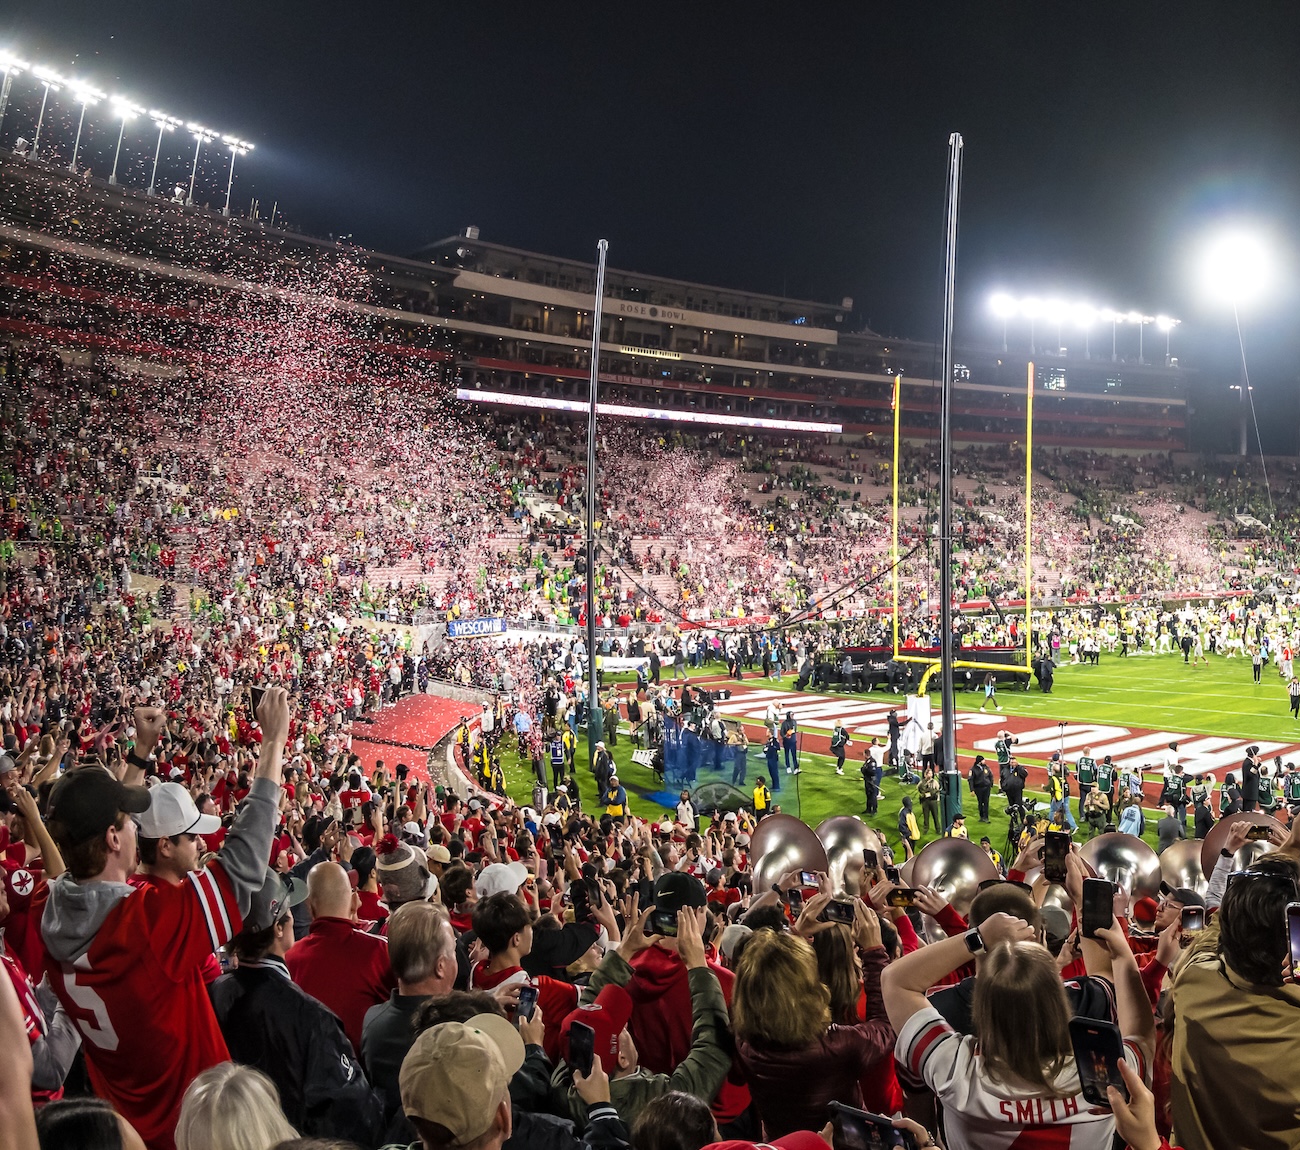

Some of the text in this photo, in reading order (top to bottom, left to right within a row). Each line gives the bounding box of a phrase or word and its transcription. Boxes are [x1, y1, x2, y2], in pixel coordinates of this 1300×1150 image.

[620, 303, 686, 321] ROSE BOWL
[454, 620, 493, 635] WESCOM
[61, 952, 120, 1051] 5
[999, 1096, 1079, 1125] SMITH
